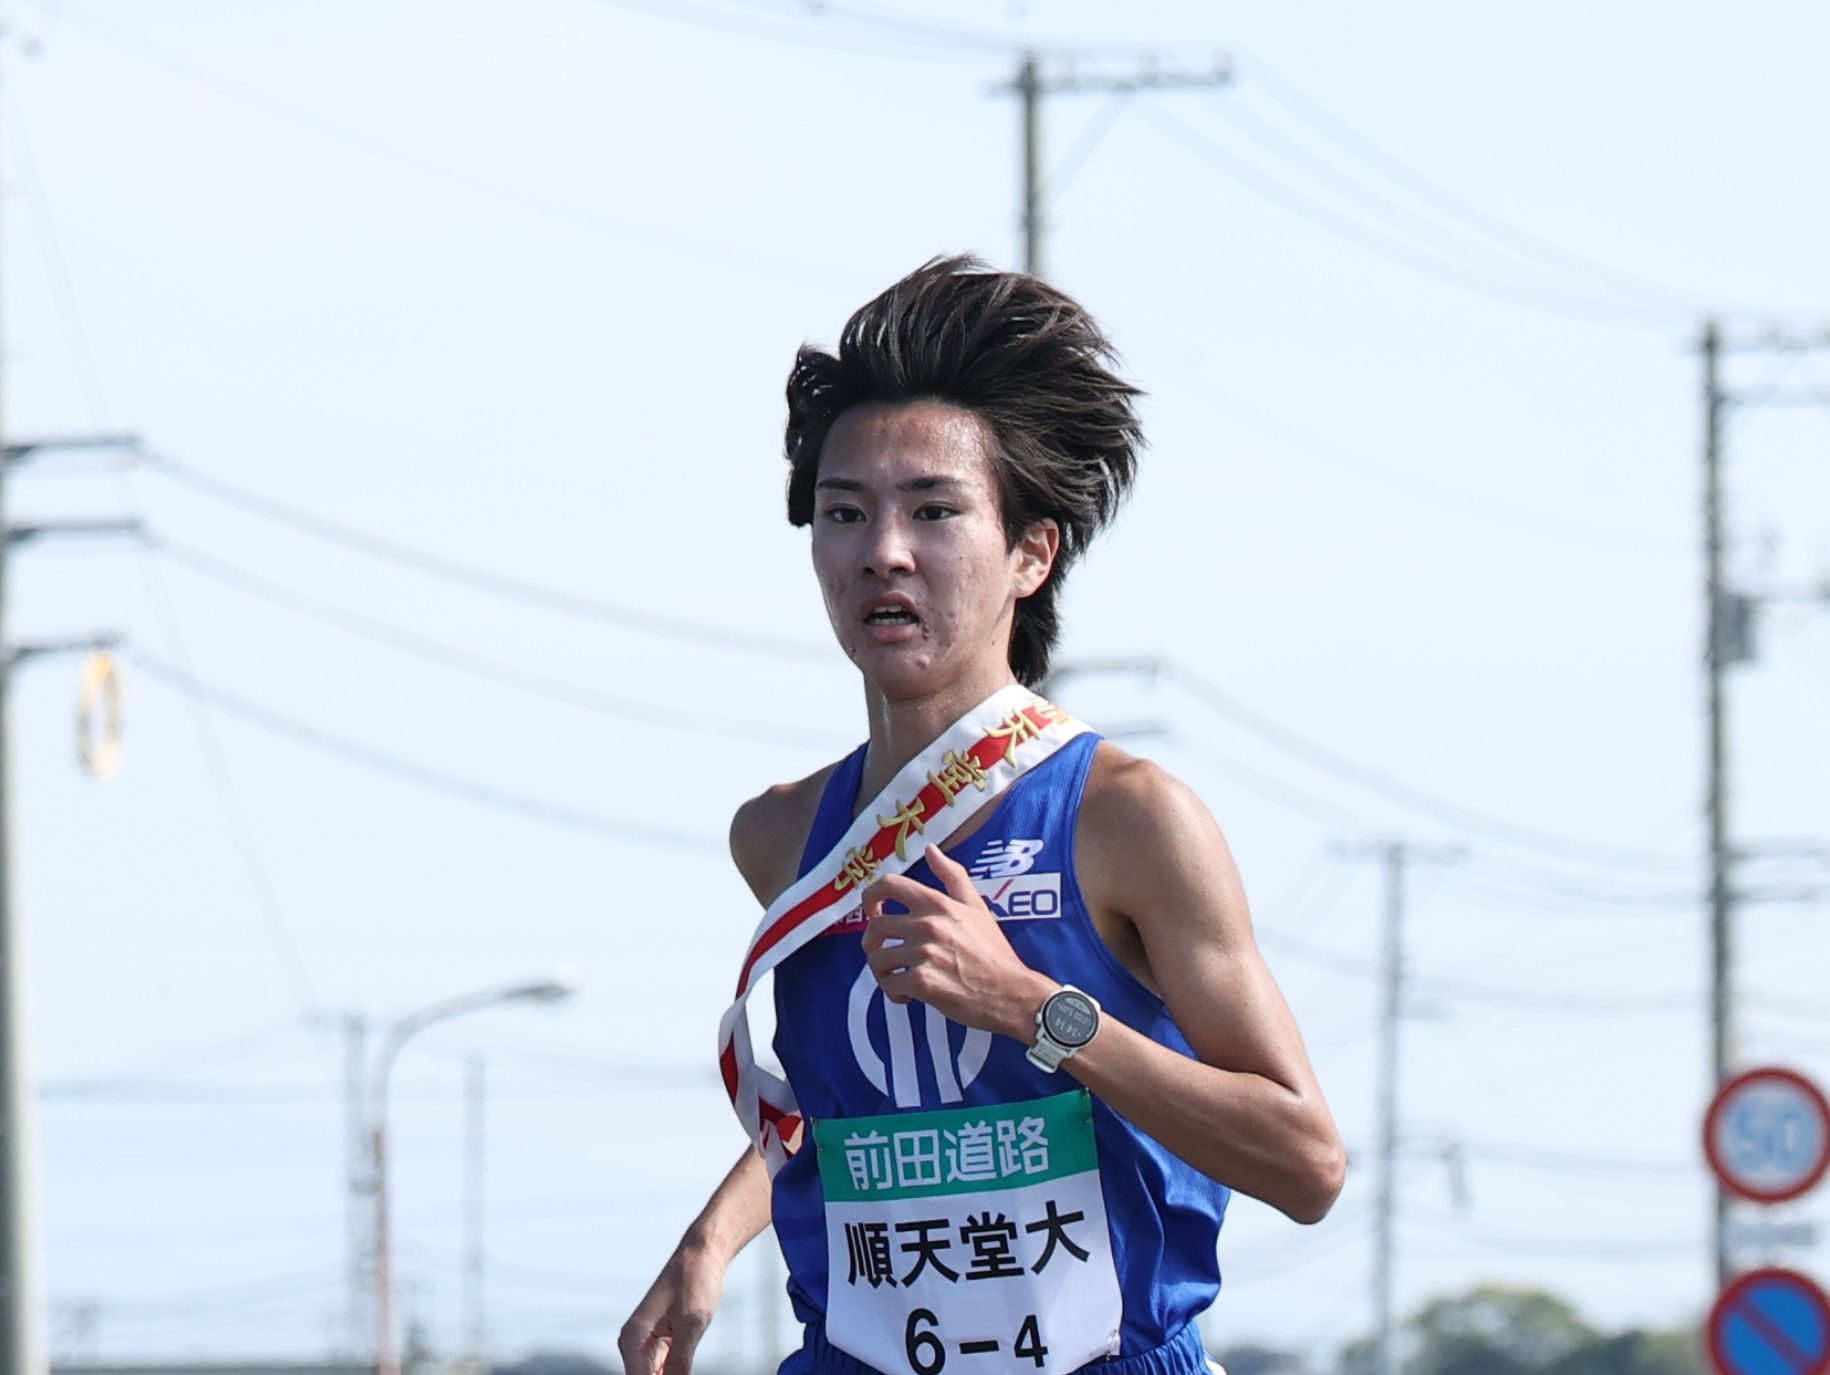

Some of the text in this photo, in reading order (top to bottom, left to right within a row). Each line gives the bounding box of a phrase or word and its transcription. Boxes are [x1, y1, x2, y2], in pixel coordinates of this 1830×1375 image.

[981, 878, 1058, 917] XEO
[843, 1115, 1050, 1191] 前田道路
[1732, 1102, 1815, 1170] 50
[843, 1200, 1090, 1289] 順天堂大
